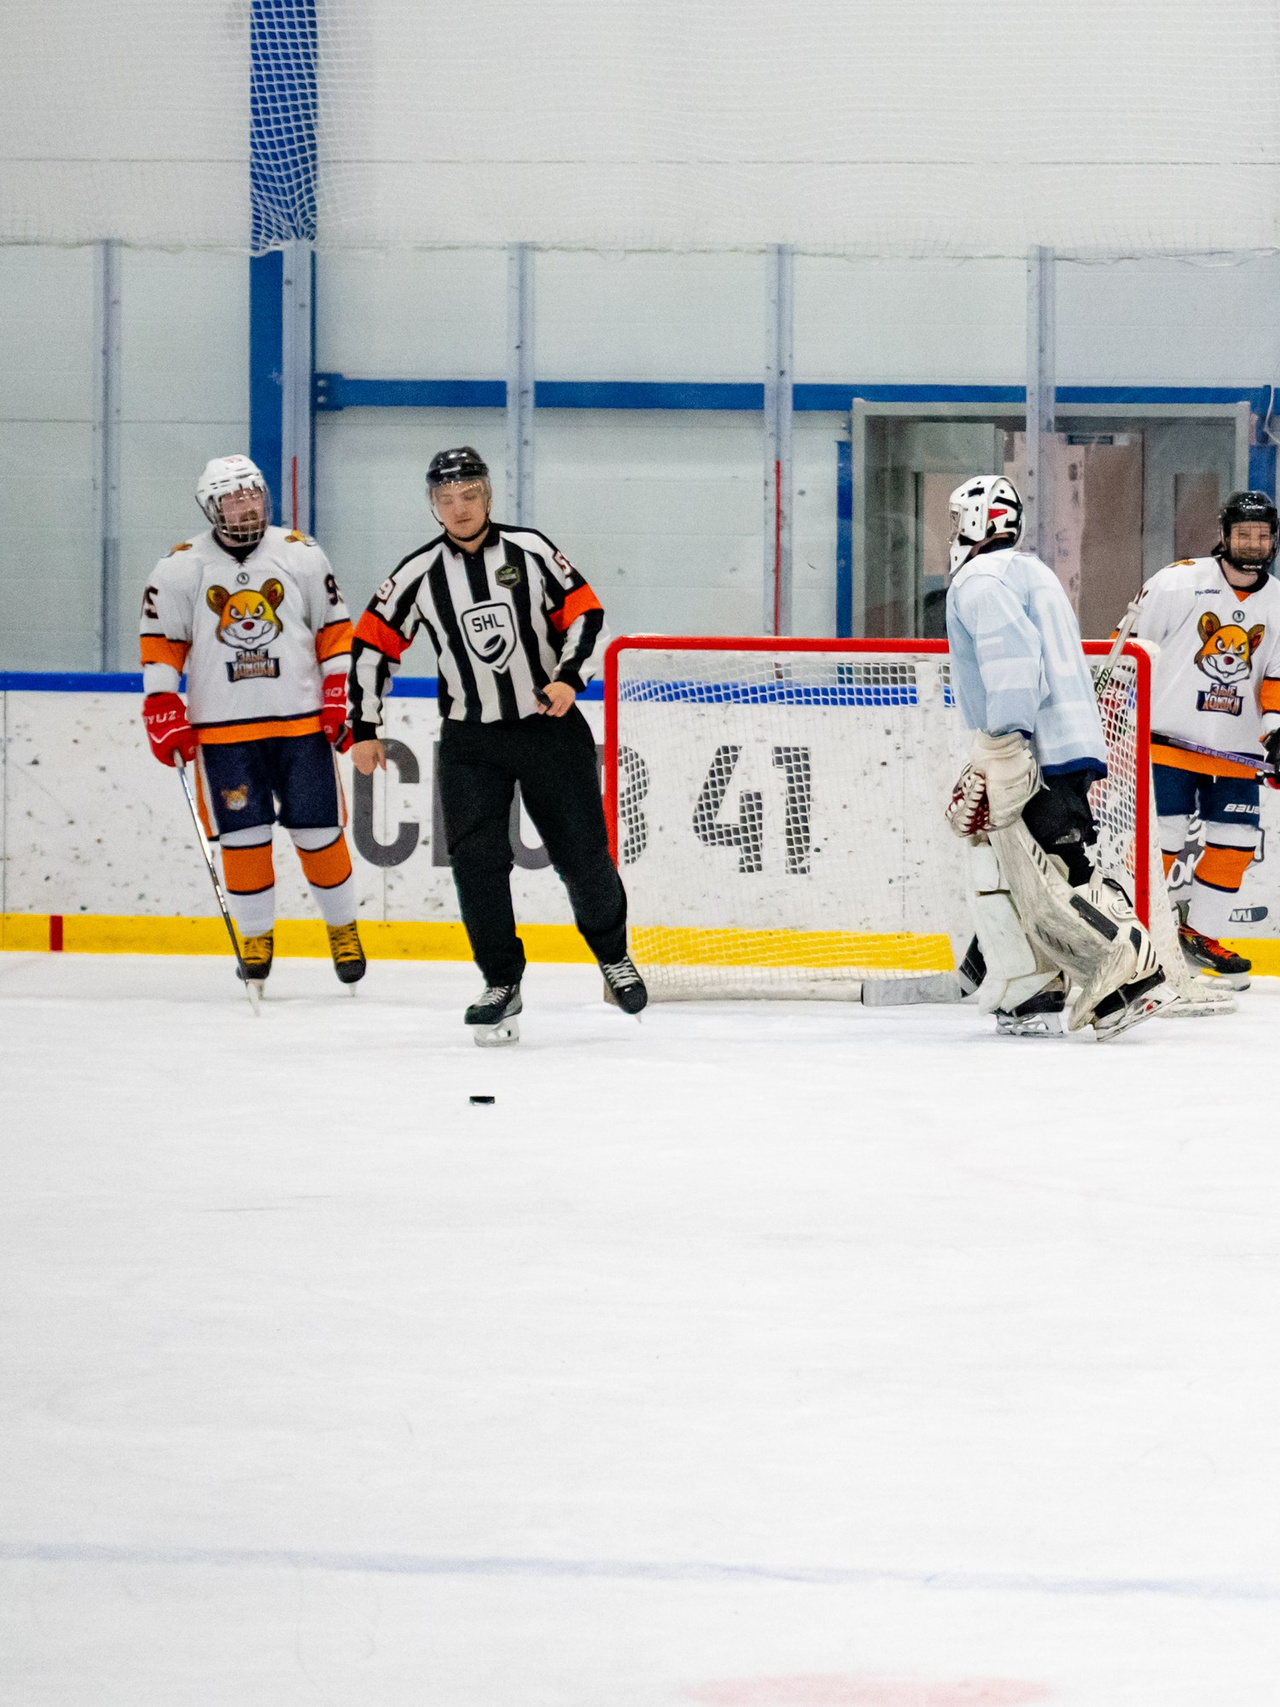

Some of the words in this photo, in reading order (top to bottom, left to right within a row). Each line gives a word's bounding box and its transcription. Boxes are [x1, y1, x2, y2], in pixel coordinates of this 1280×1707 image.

[140, 585, 159, 620] 5
[324, 573, 343, 606] 9
[472, 614, 505, 632] SHL
[692, 745, 811, 874] 41
[1224, 803, 1260, 815] BAUE
